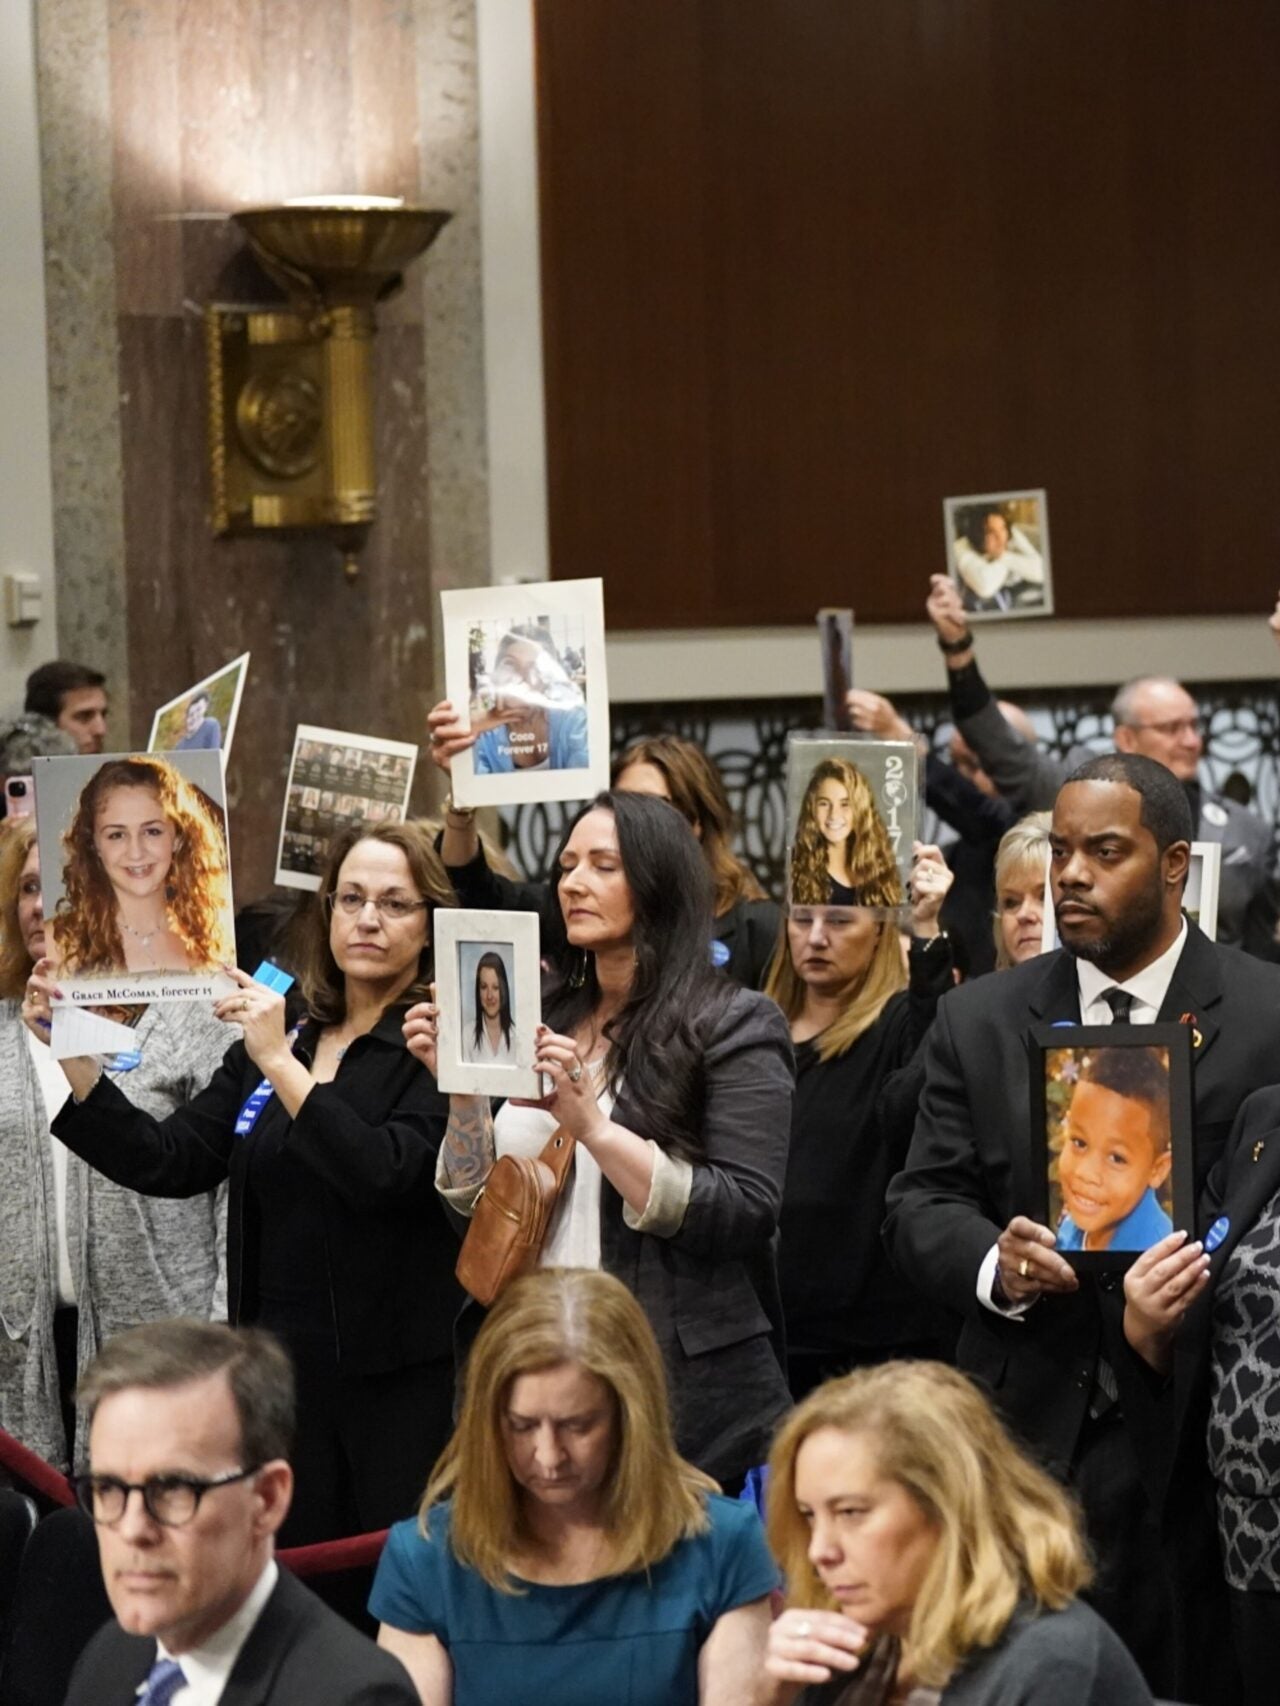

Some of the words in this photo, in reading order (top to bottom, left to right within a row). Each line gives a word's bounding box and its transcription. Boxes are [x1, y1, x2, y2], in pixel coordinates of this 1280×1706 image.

[509, 732, 535, 742] Coco
[497, 745, 535, 755] Forever
[537, 742, 548, 753] 17
[161, 986, 199, 997] forever
[202, 987, 212, 996] 15
